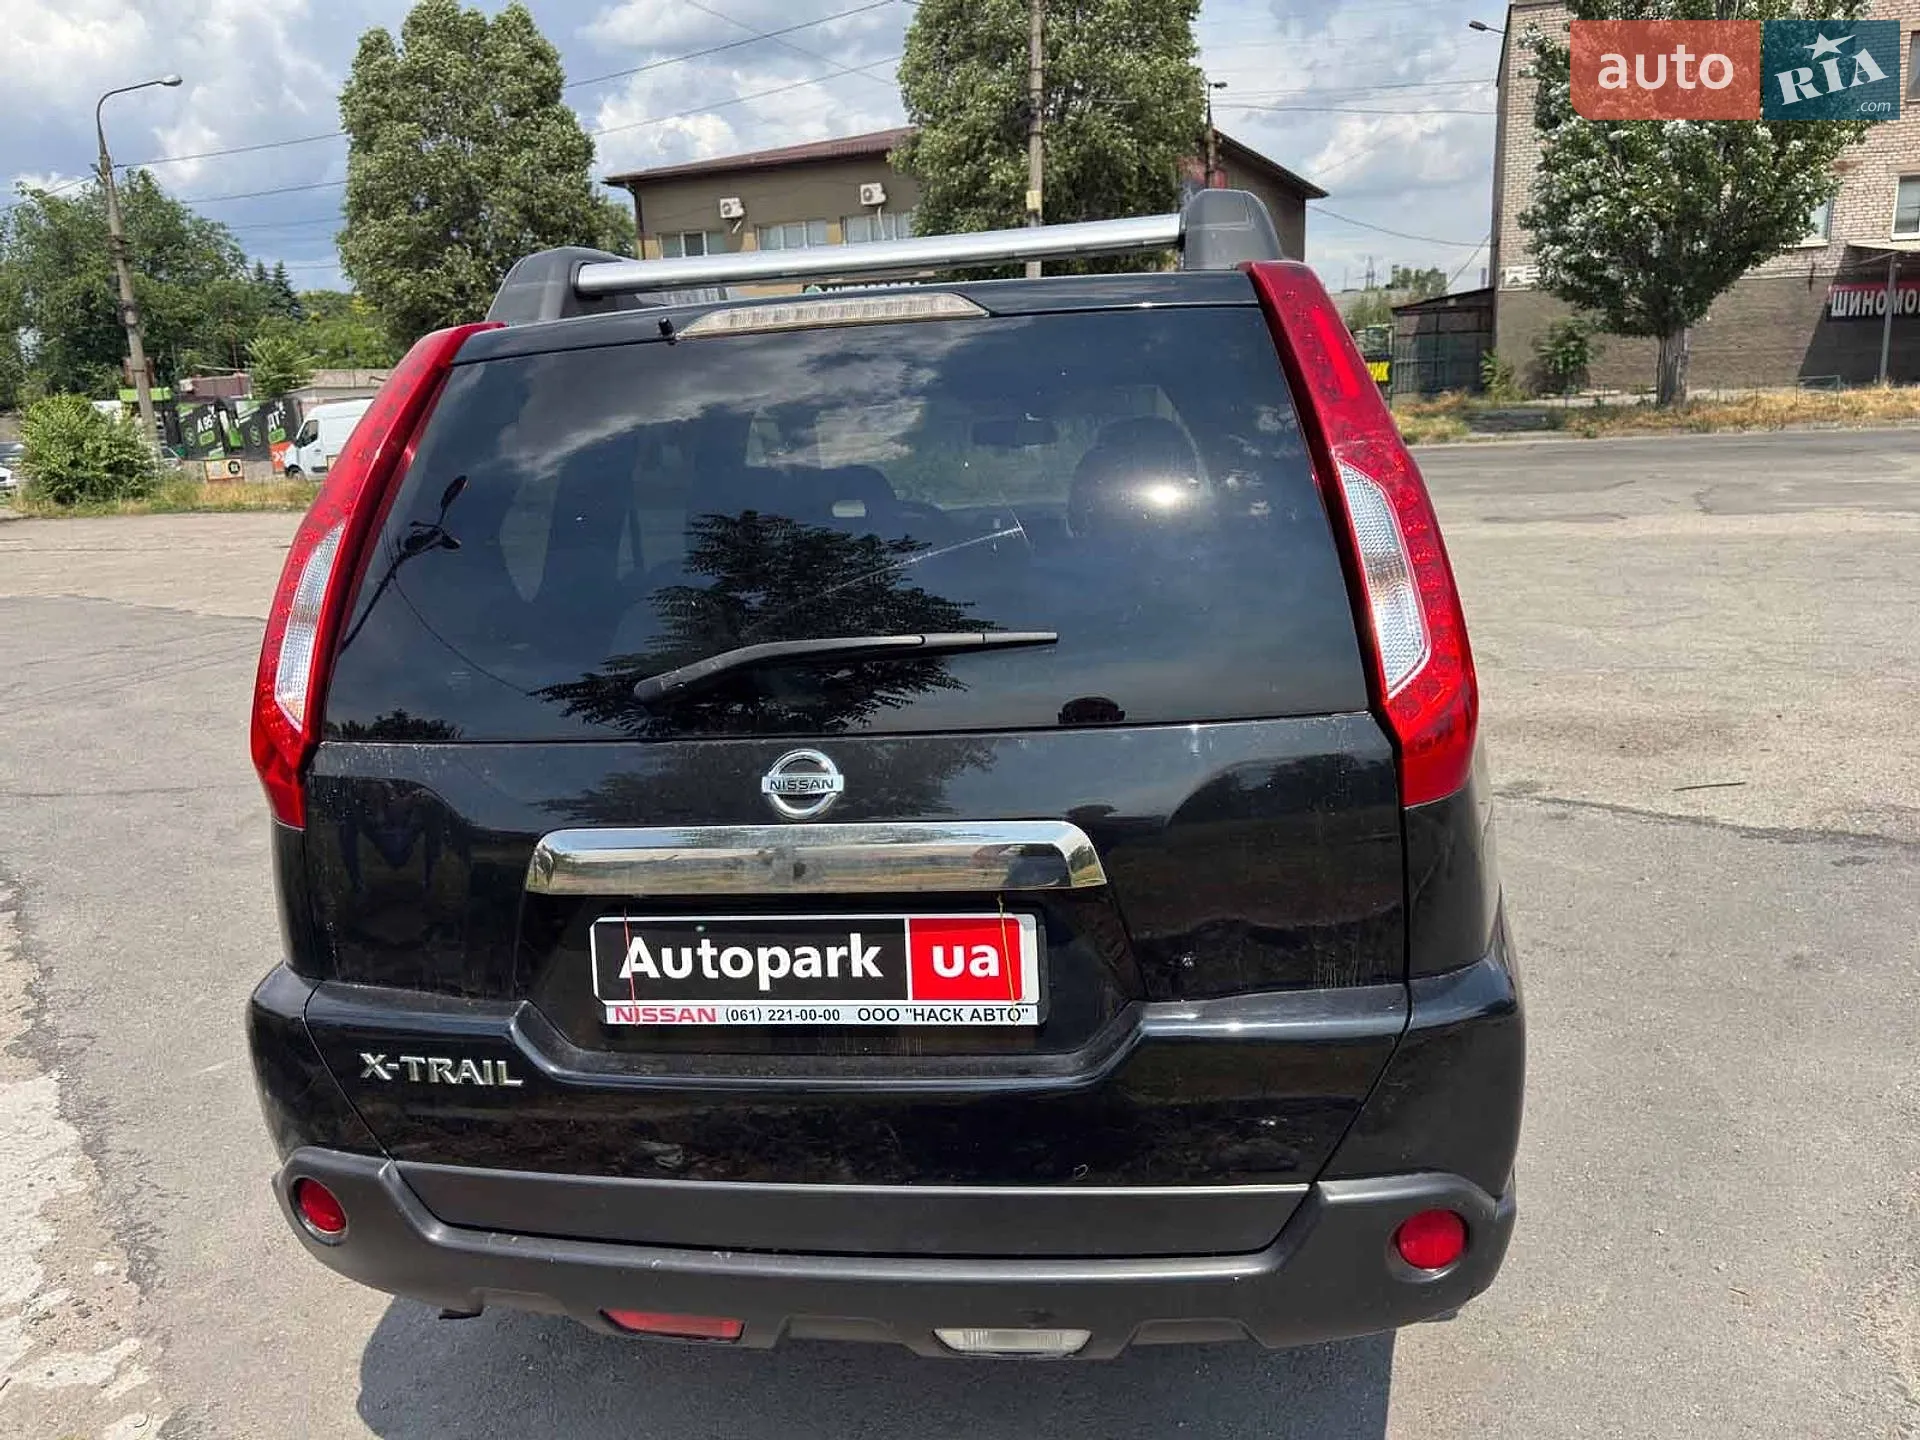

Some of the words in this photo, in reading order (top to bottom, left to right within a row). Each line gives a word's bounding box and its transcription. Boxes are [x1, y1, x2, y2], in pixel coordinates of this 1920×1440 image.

[1831, 288, 1920, 317] ШИНОМО
[769, 778, 834, 791] NISSAN
[618, 932, 884, 992] Autopark
[932, 943, 1000, 978] ua
[614, 1006, 717, 1023] NISSAN
[725, 1007, 762, 1023] (061)
[768, 1007, 840, 1022] 221-00-00
[857, 1007, 900, 1022] ООО
[905, 1006, 964, 1022] "НАСК
[969, 1006, 1029, 1022] АВТО"
[360, 1052, 524, 1087] X-TRAIL
